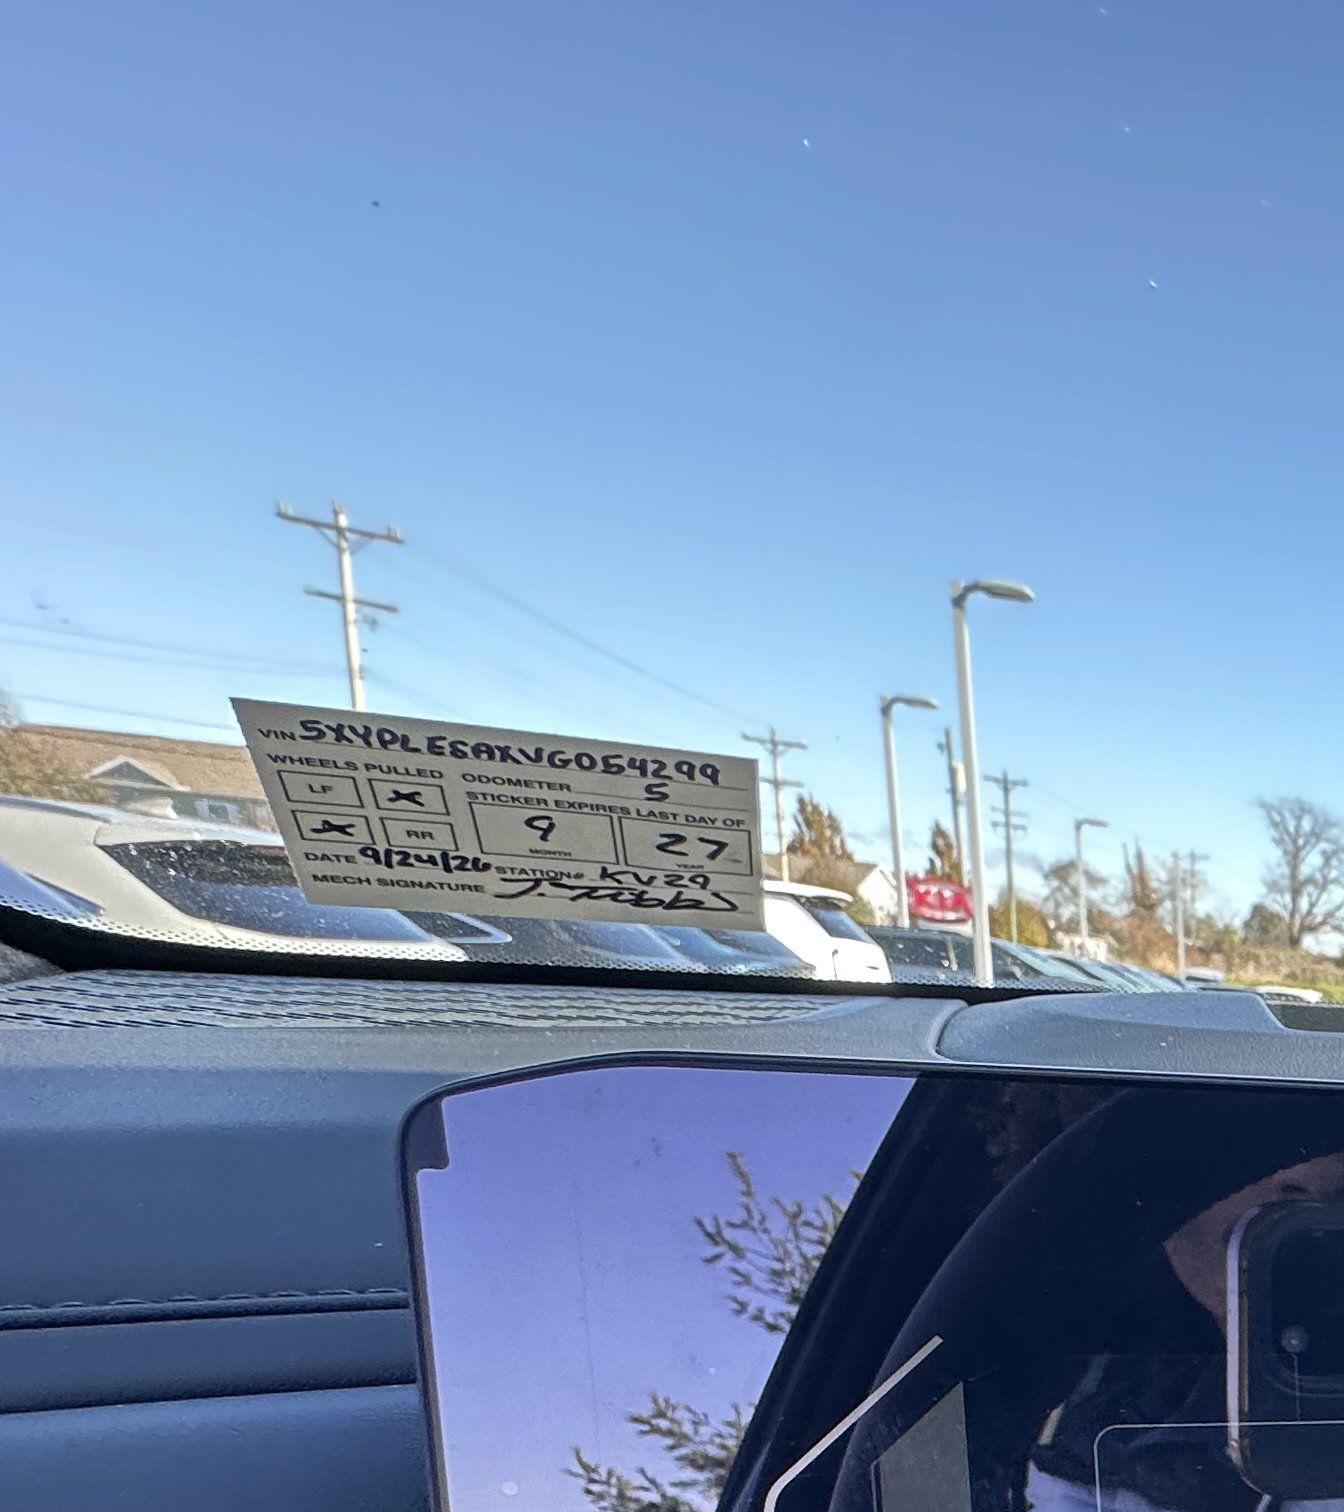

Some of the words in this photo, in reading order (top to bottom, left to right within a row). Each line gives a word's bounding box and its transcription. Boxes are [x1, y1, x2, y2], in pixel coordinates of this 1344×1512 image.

[257, 728, 297, 741] VIN
[267, 753, 359, 771] WHEELS
[364, 763, 444, 779] PULLED
[307, 783, 333, 794] LF
[461, 772, 572, 792] ODOMETER
[465, 790, 550, 808] STICKER
[553, 799, 631, 816] EXPIRES
[636, 806, 681, 822] LAST
[684, 813, 719, 827] DAY
[722, 817, 746, 829] OF
[406, 829, 435, 840] RR
[523, 814, 556, 842] 9
[655, 832, 730, 861] 27
[304, 852, 359, 865] DATE
[358, 846, 492, 874] 9/24/26
[311, 873, 371, 886] MECH
[376, 878, 485, 893] SIGNATURE
